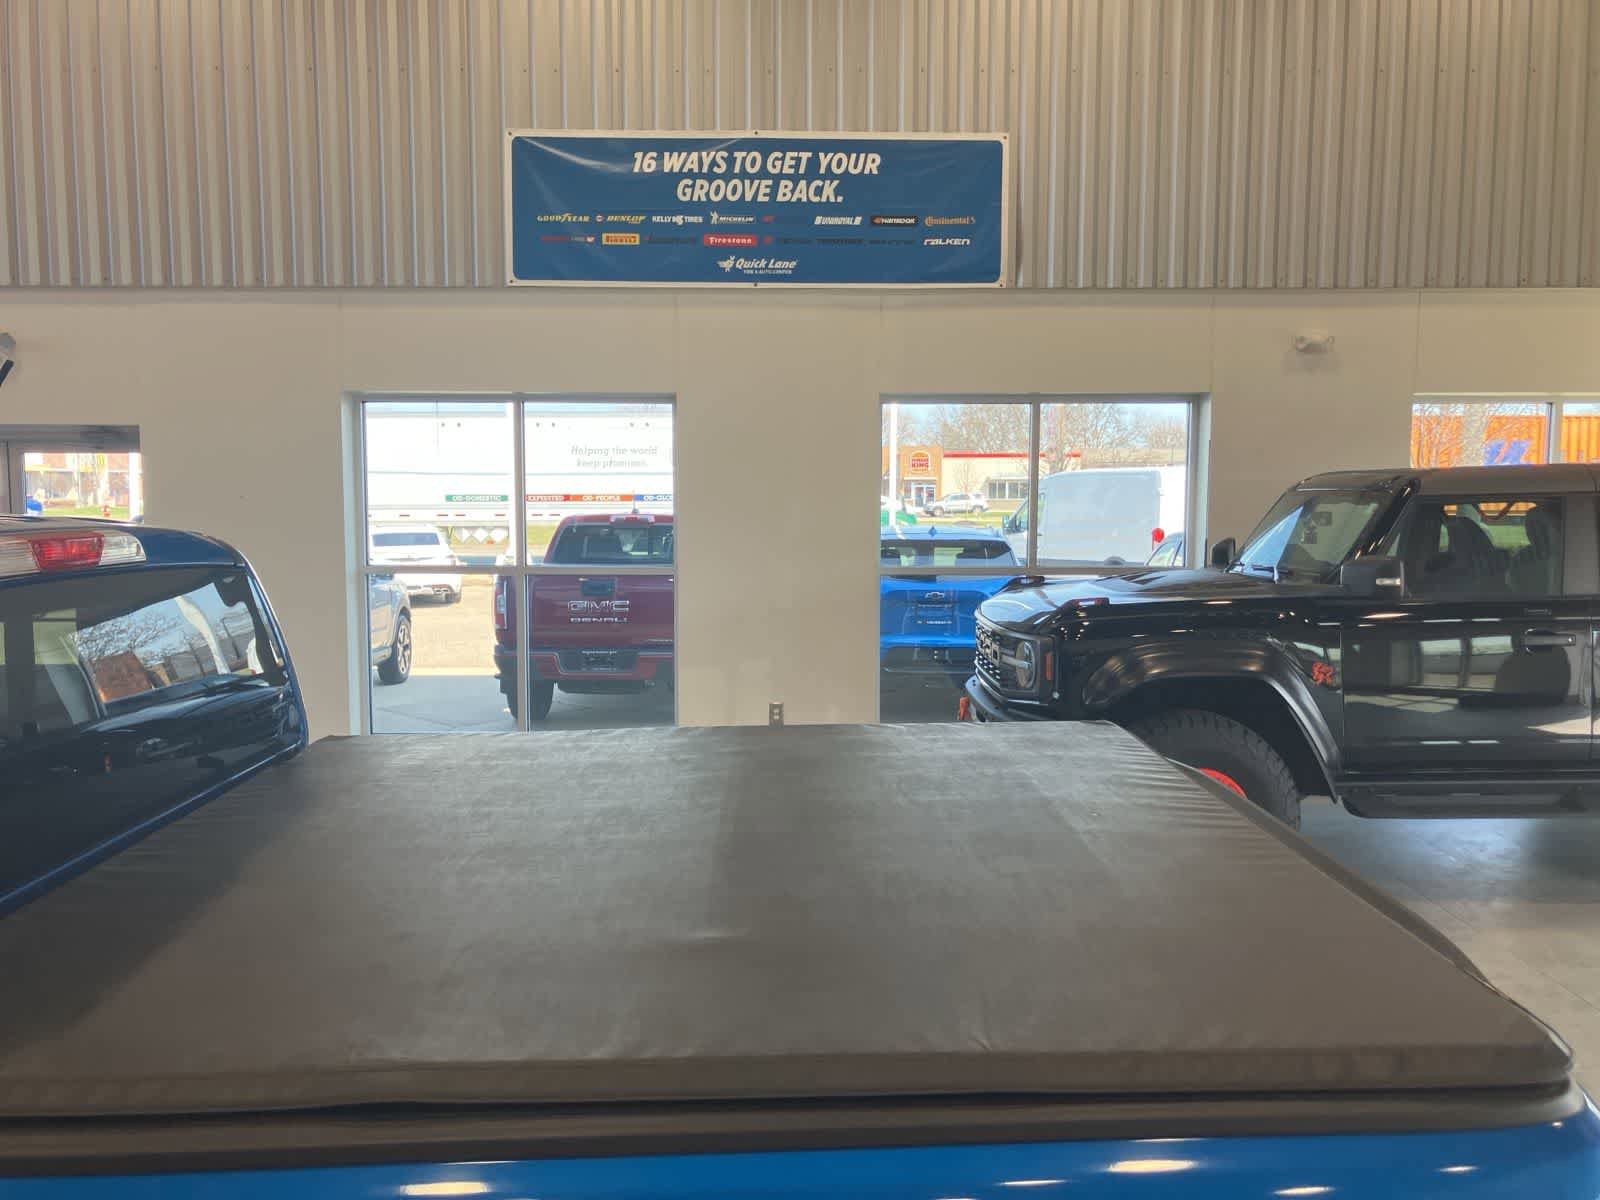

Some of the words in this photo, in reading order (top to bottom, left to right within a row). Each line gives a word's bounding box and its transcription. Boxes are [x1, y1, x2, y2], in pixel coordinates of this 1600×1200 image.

[632, 151, 657, 173] 16
[663, 151, 728, 174] WAYS
[733, 151, 762, 174] TO
[766, 152, 812, 175] GET
[818, 152, 881, 175] YOUR
[676, 178, 772, 202] GROOVE
[776, 179, 843, 202] BACK.
[537, 213, 590, 222] GOODYEAR
[607, 215, 646, 223] DUNLOP
[709, 237, 752, 245] Firestone
[924, 238, 970, 246] FALKEN
[736, 258, 767, 269] Quick
[768, 258, 797, 269] Lane
[571, 445, 609, 456] Helping
[612, 445, 627, 455] the
[630, 445, 658, 455] world
[568, 600, 630, 612] GMC
